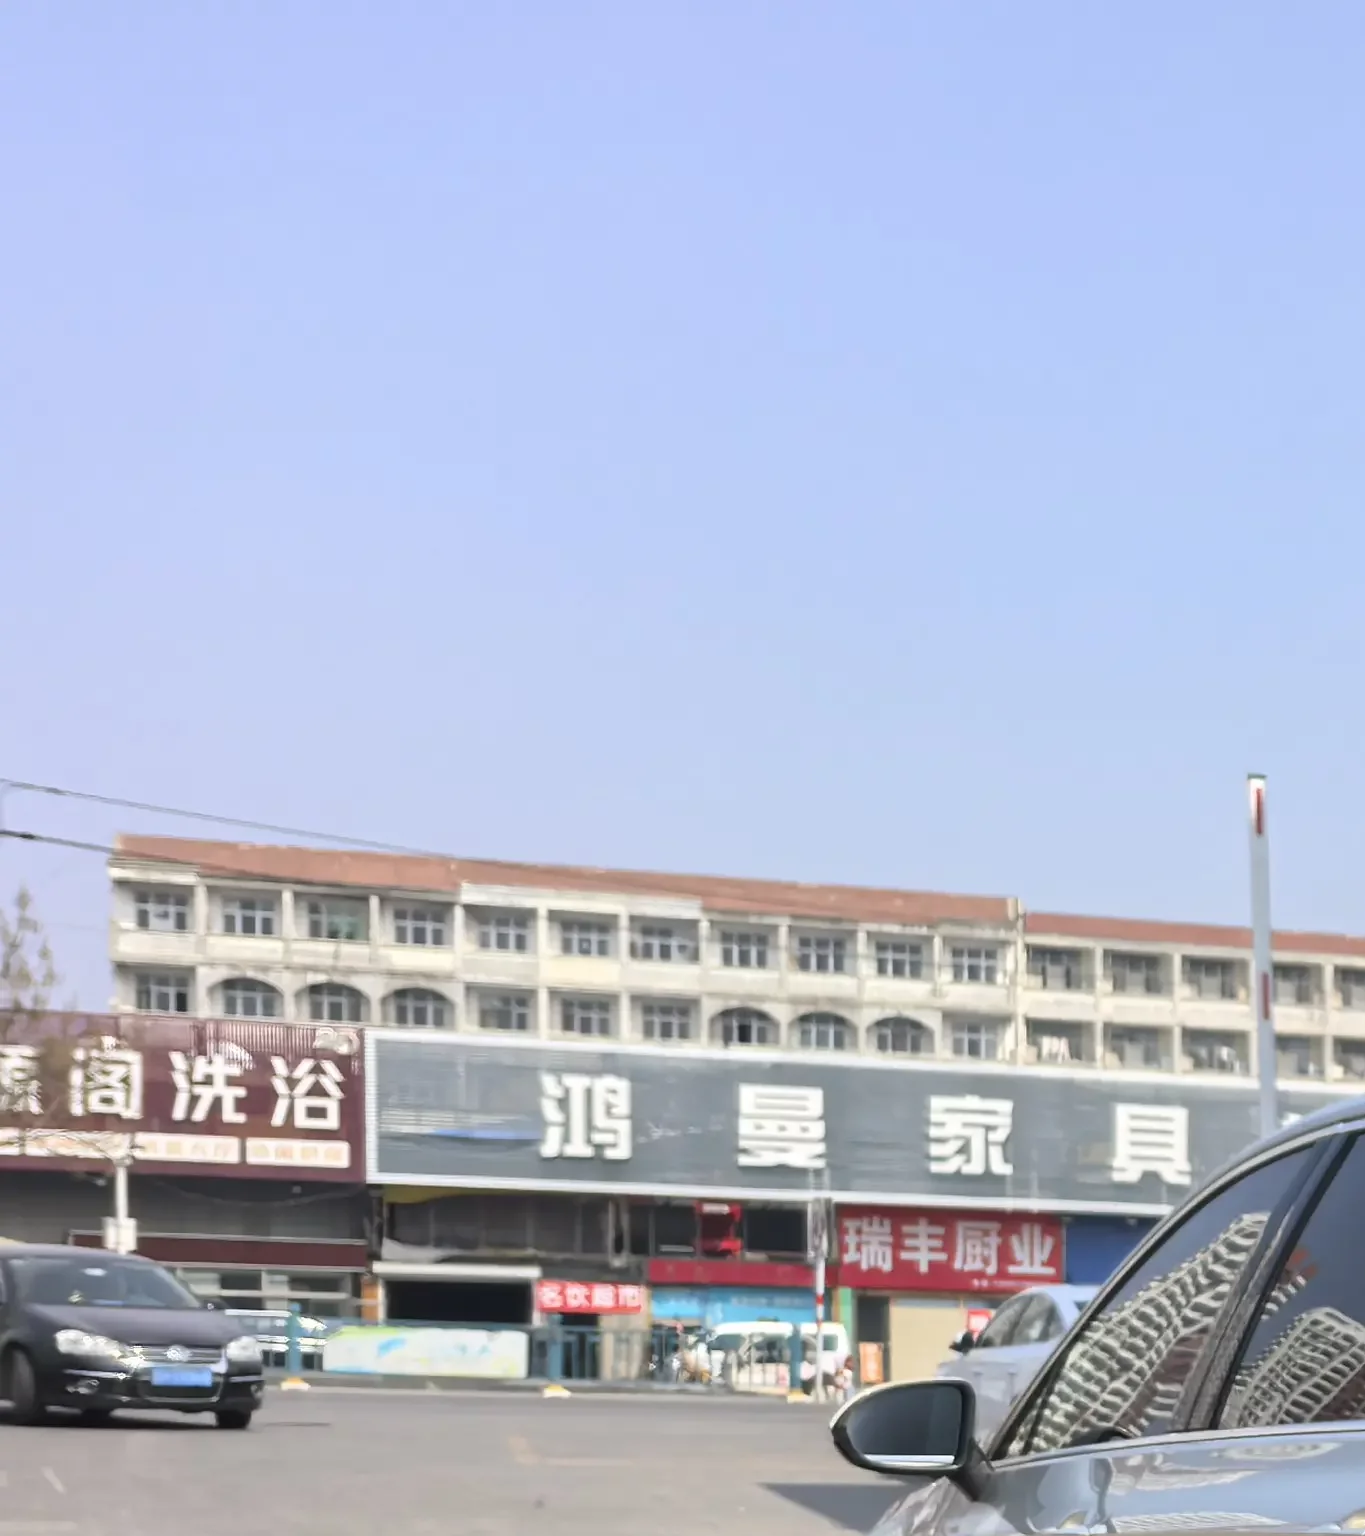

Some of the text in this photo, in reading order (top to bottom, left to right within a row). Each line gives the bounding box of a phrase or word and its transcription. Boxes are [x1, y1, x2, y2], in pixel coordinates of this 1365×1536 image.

[540, 1072, 1192, 1186] 鸿曼家具
[842, 1215, 1056, 1276] 瑞丰厨业
